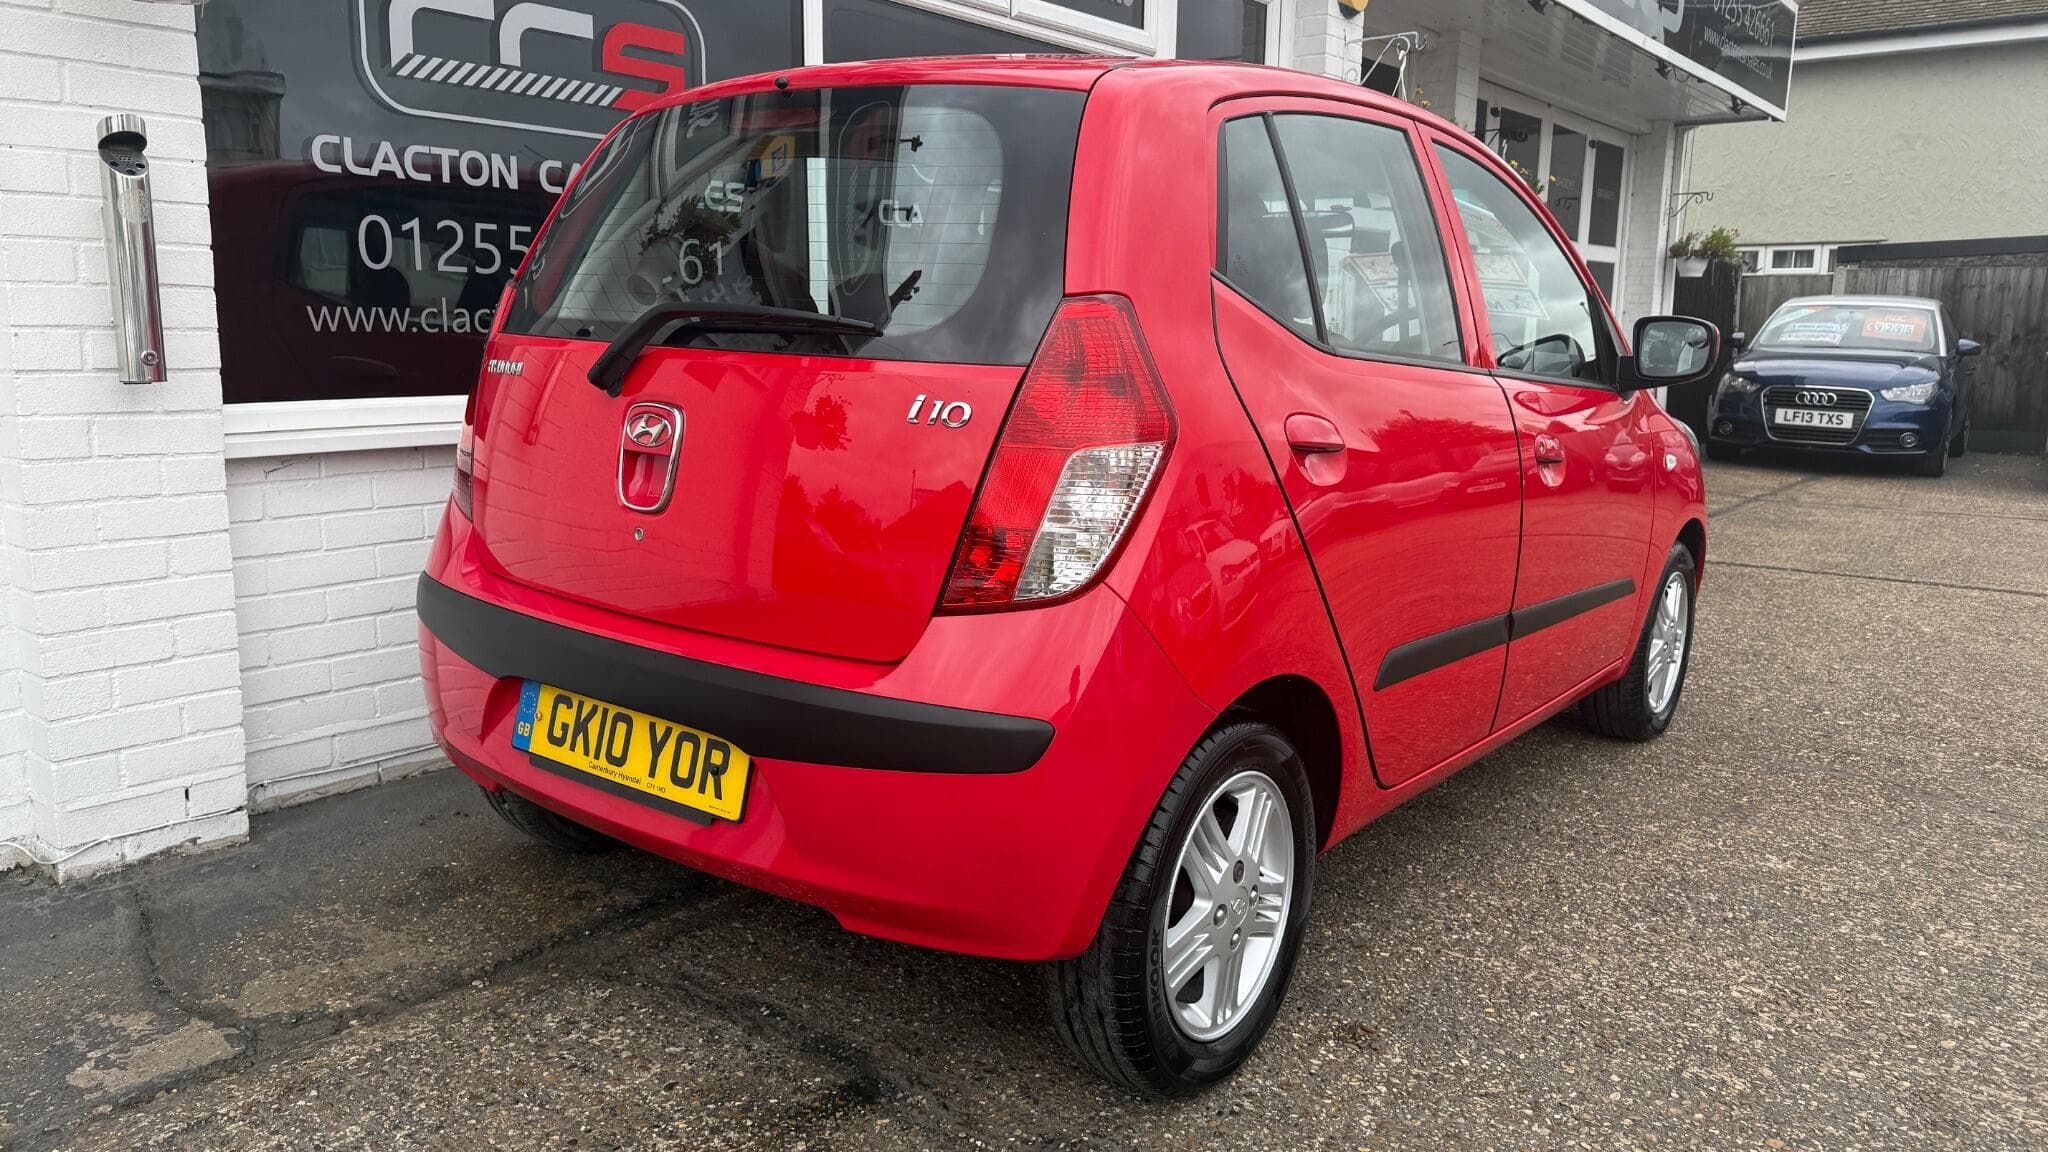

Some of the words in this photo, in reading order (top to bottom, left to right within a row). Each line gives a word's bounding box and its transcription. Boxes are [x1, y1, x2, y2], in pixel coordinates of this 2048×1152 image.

[1744, 3, 1775, 49] 426661
[310, 134, 518, 190] CLACTON
[305, 297, 497, 334] www.clac
[1783, 410, 1815, 424] LF13
[1818, 413, 1845, 426] TXS
[517, 721, 530, 737] GB
[546, 693, 634, 768] GK10
[648, 720, 731, 801] YOR
